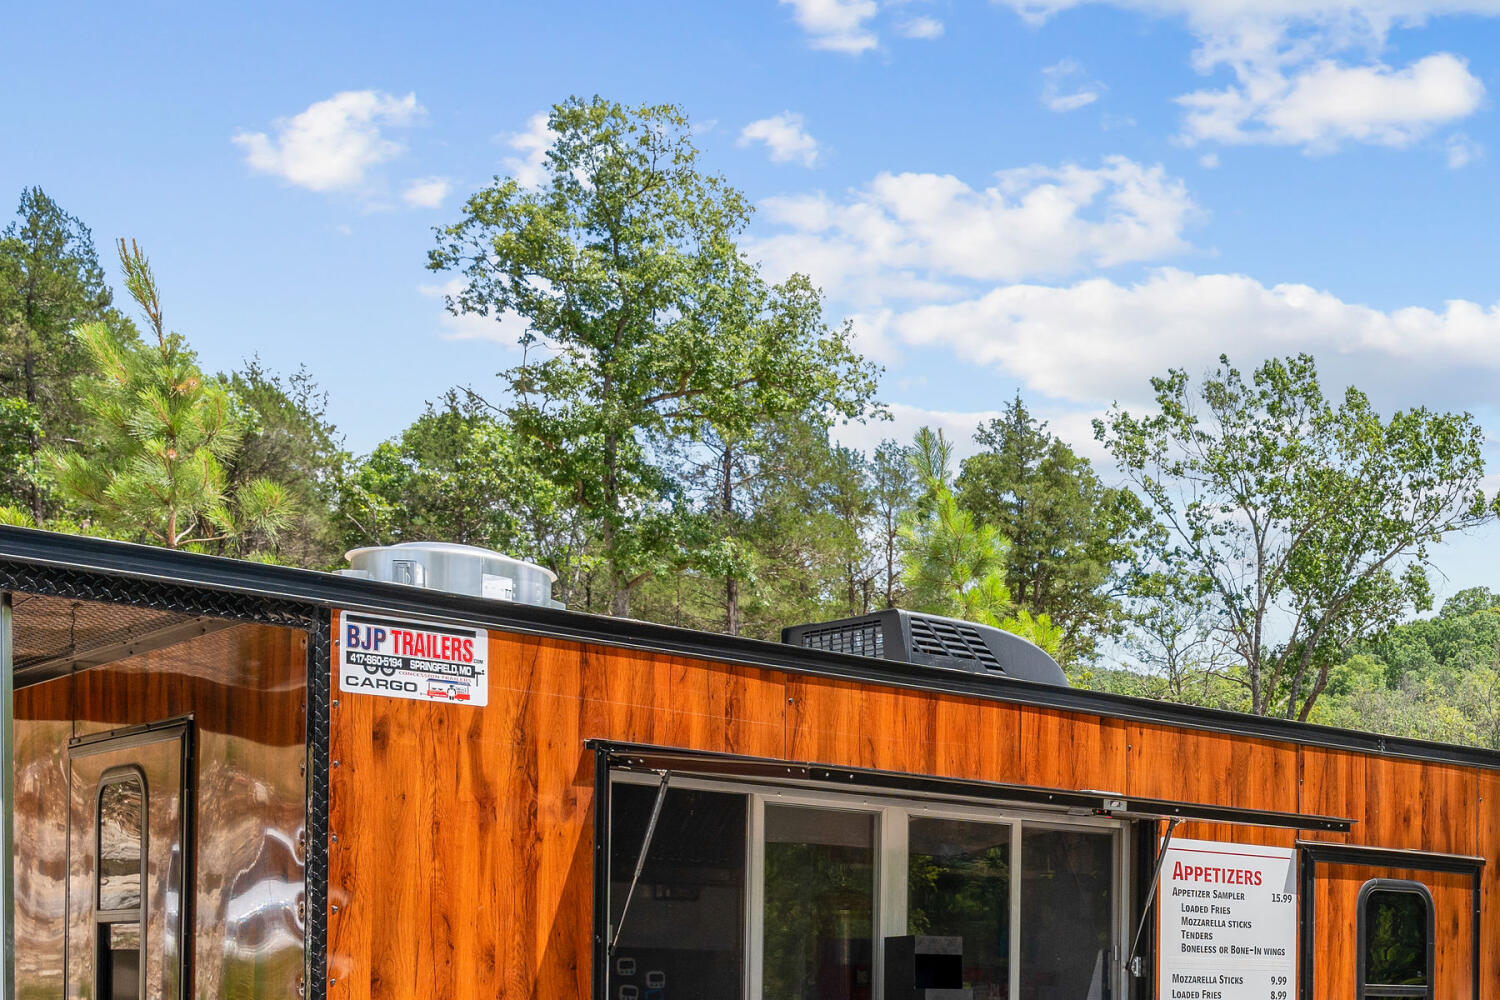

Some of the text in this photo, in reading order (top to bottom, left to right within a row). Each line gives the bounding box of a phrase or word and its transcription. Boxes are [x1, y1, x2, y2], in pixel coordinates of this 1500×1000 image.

[347, 624, 473, 664] BJP TRAILERS
[410, 660, 472, 676] SPRINGFIELD, MO
[346, 675, 418, 692] CARGO
[1172, 860, 1262, 886] APPETIZERS
[1172, 887, 1292, 903] APPETIZER SAMPLER 15.99
[1181, 903, 1231, 914] LOADED FRIES
[1181, 917, 1252, 929] MOZZARELLA STICKS
[1181, 930, 1213, 940] TENDERS
[1181, 944, 1216, 954] BONELESS
[1230, 945, 1261, 955] BONE-IN
[1264, 948, 1285, 956] WINGS
[1172, 974, 1287, 985] MOZZARELLA STICKS 9.99
[1172, 989, 1287, 1000] LOADED FRIES 8.99
